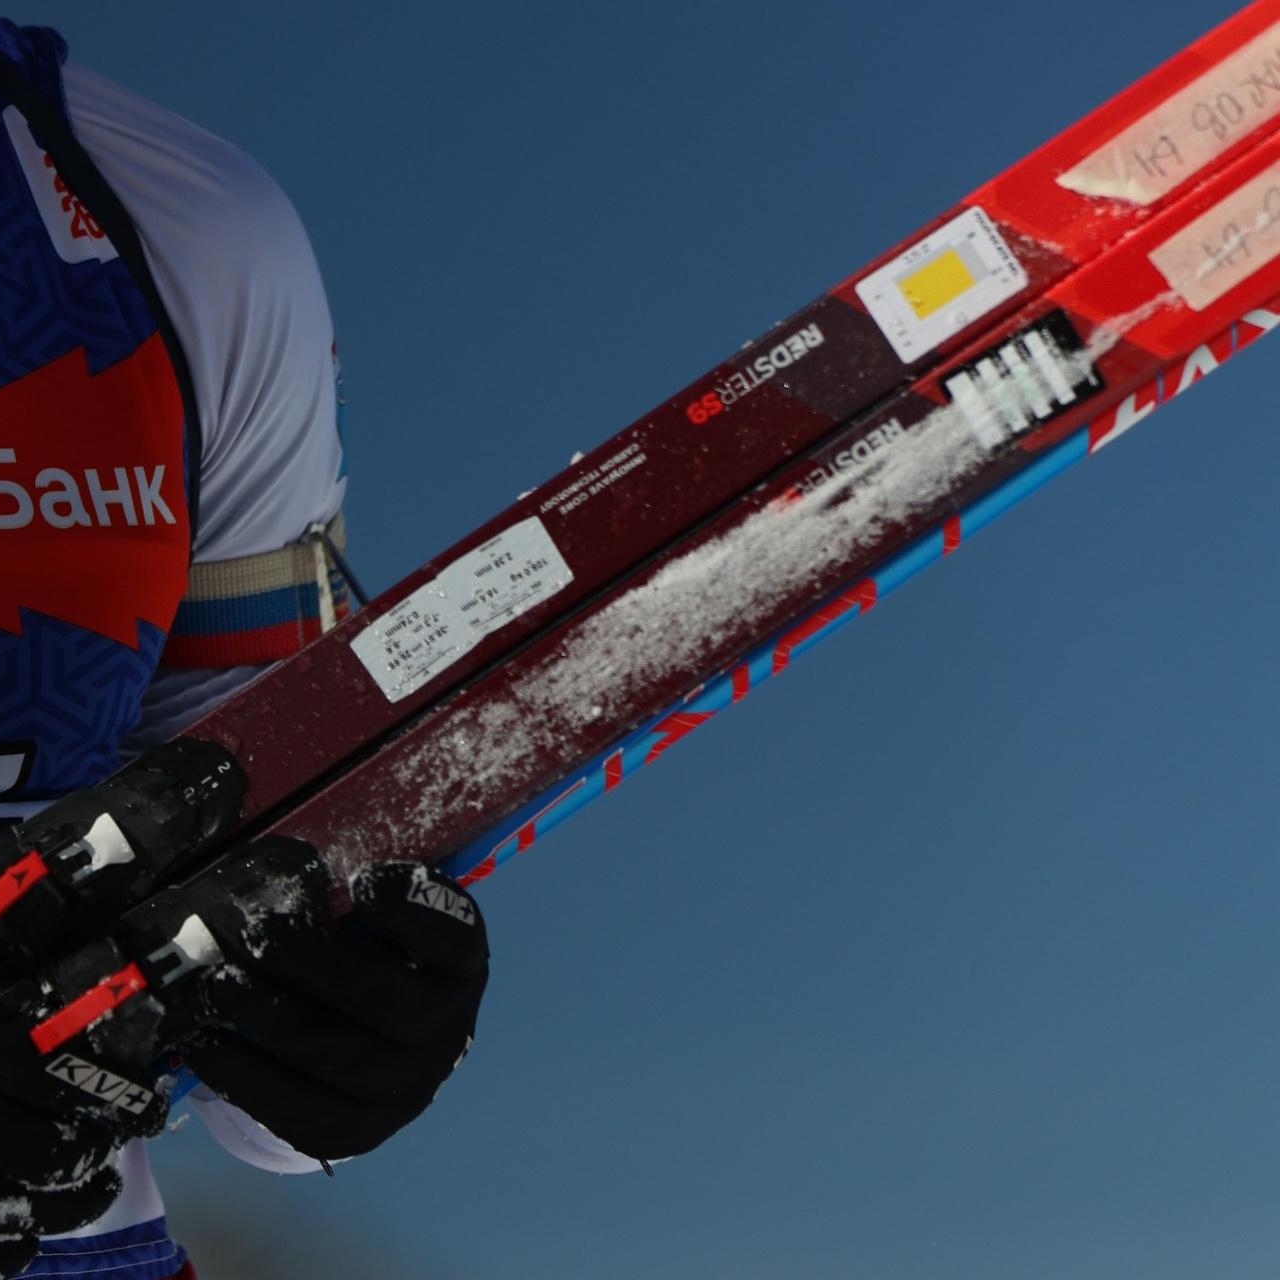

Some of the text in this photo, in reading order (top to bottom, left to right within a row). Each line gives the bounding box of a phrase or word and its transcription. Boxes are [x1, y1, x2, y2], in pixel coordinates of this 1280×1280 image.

[712, 321, 826, 407] REDSTER
[537, 440, 641, 514] CARBON TECHNOLOGY
[557, 451, 647, 516] INNOWAVE CORE
[44, 1051, 153, 1116] KV+
